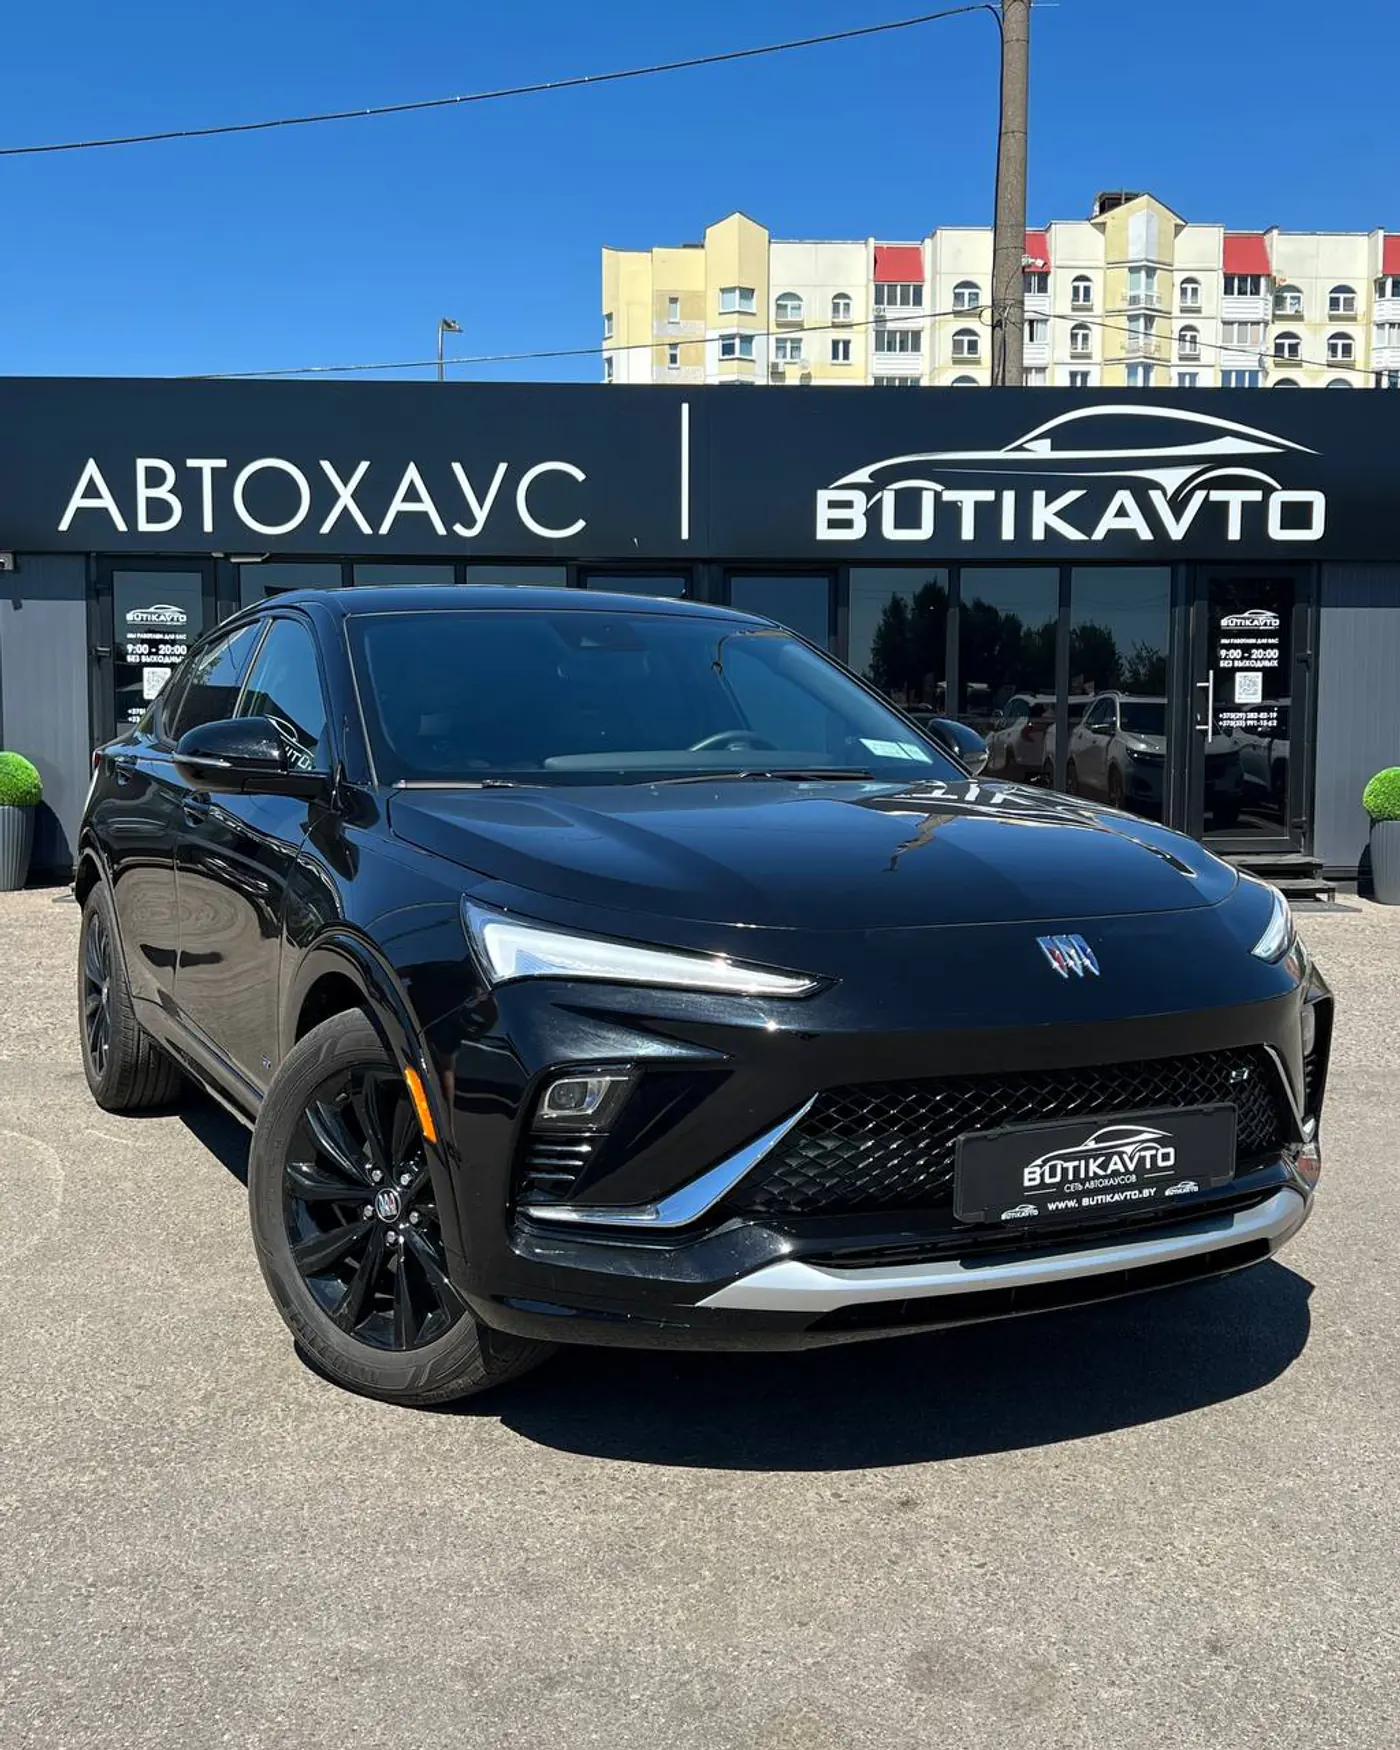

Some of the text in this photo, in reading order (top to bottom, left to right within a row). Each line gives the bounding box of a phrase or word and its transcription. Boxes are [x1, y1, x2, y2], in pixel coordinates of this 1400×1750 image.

[58, 457, 588, 538] АВТОХАУС
[815, 489, 1325, 541] BUTIKAVTO
[126, 643, 149, 654] 9:00
[158, 644, 187, 655] 20:00
[1220, 649, 1242, 659] 9:00
[1251, 649, 1279, 659] 20:00
[141, 655, 184, 663] ВЫХОДНЫ
[1023, 1147, 1175, 1187] BUTIKAVTO
[1063, 1174, 1137, 1193] СЕТЬ АВТОХАУСОВ
[1082, 1187, 1157, 1206] BUTIKAVTO.BY
